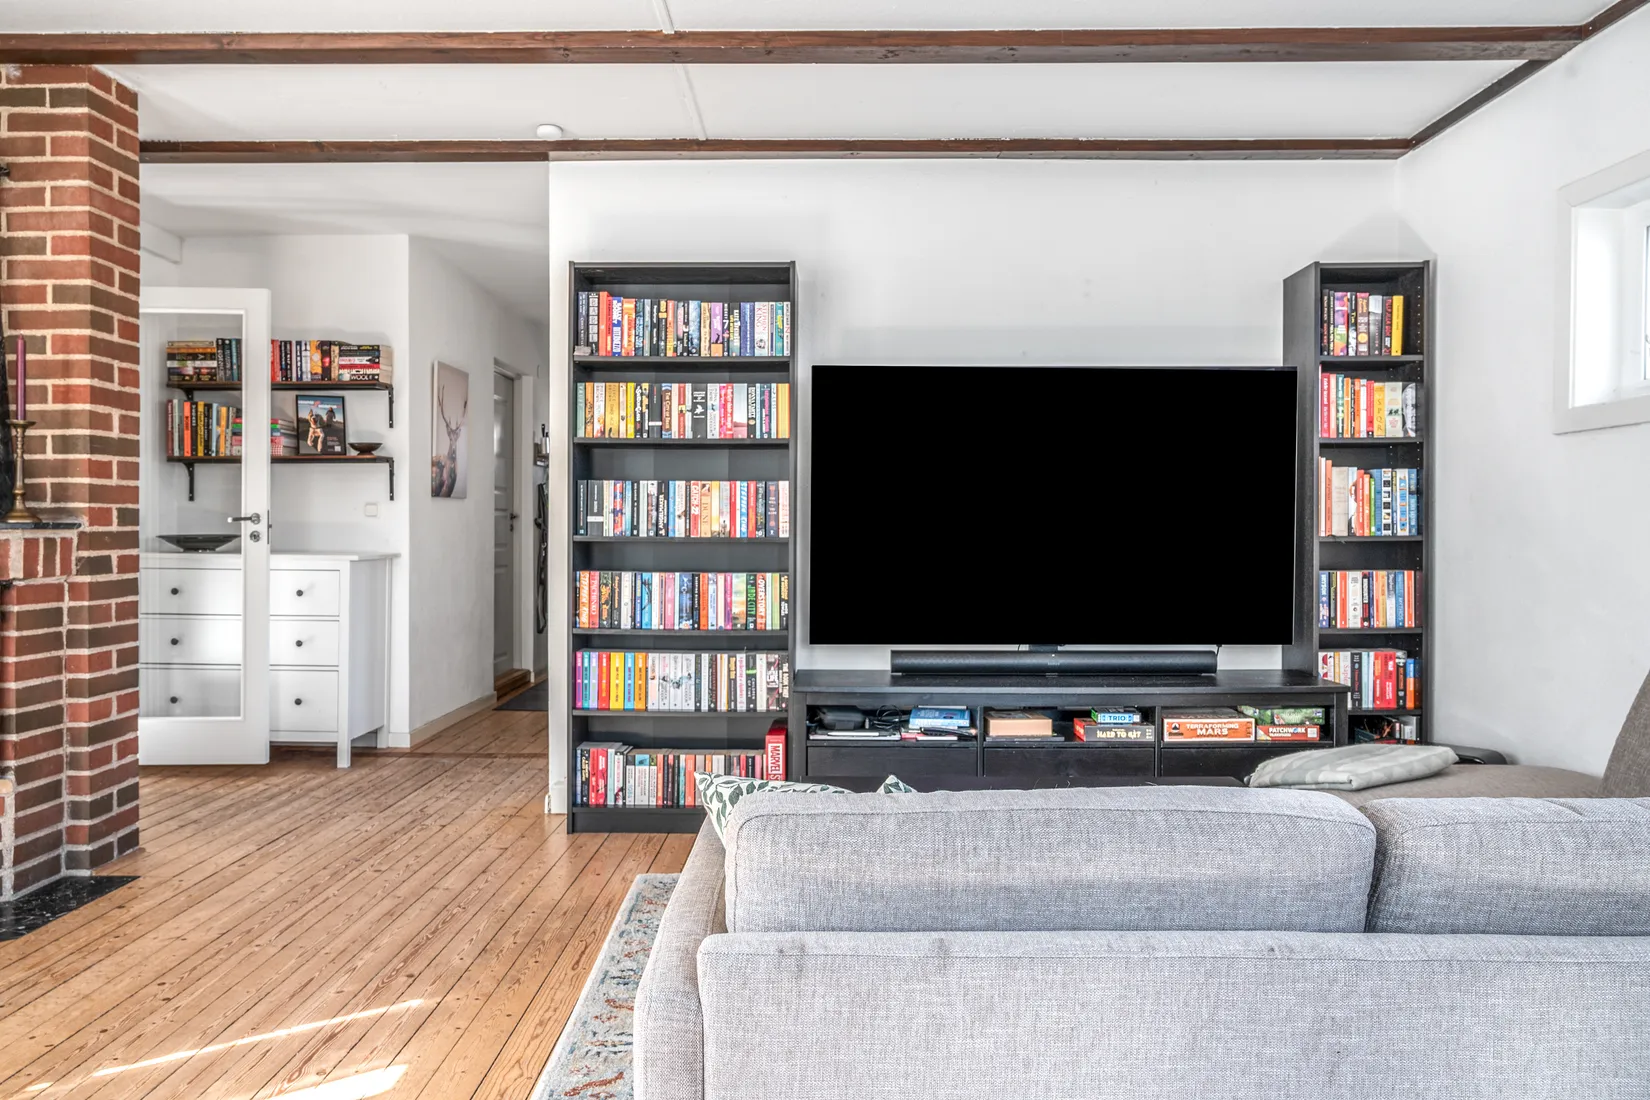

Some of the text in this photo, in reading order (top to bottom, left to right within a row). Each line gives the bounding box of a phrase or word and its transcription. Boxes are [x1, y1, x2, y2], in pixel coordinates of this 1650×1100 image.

[748, 585, 756, 615] JADE CITY
[770, 746, 780, 772] MARVEL
